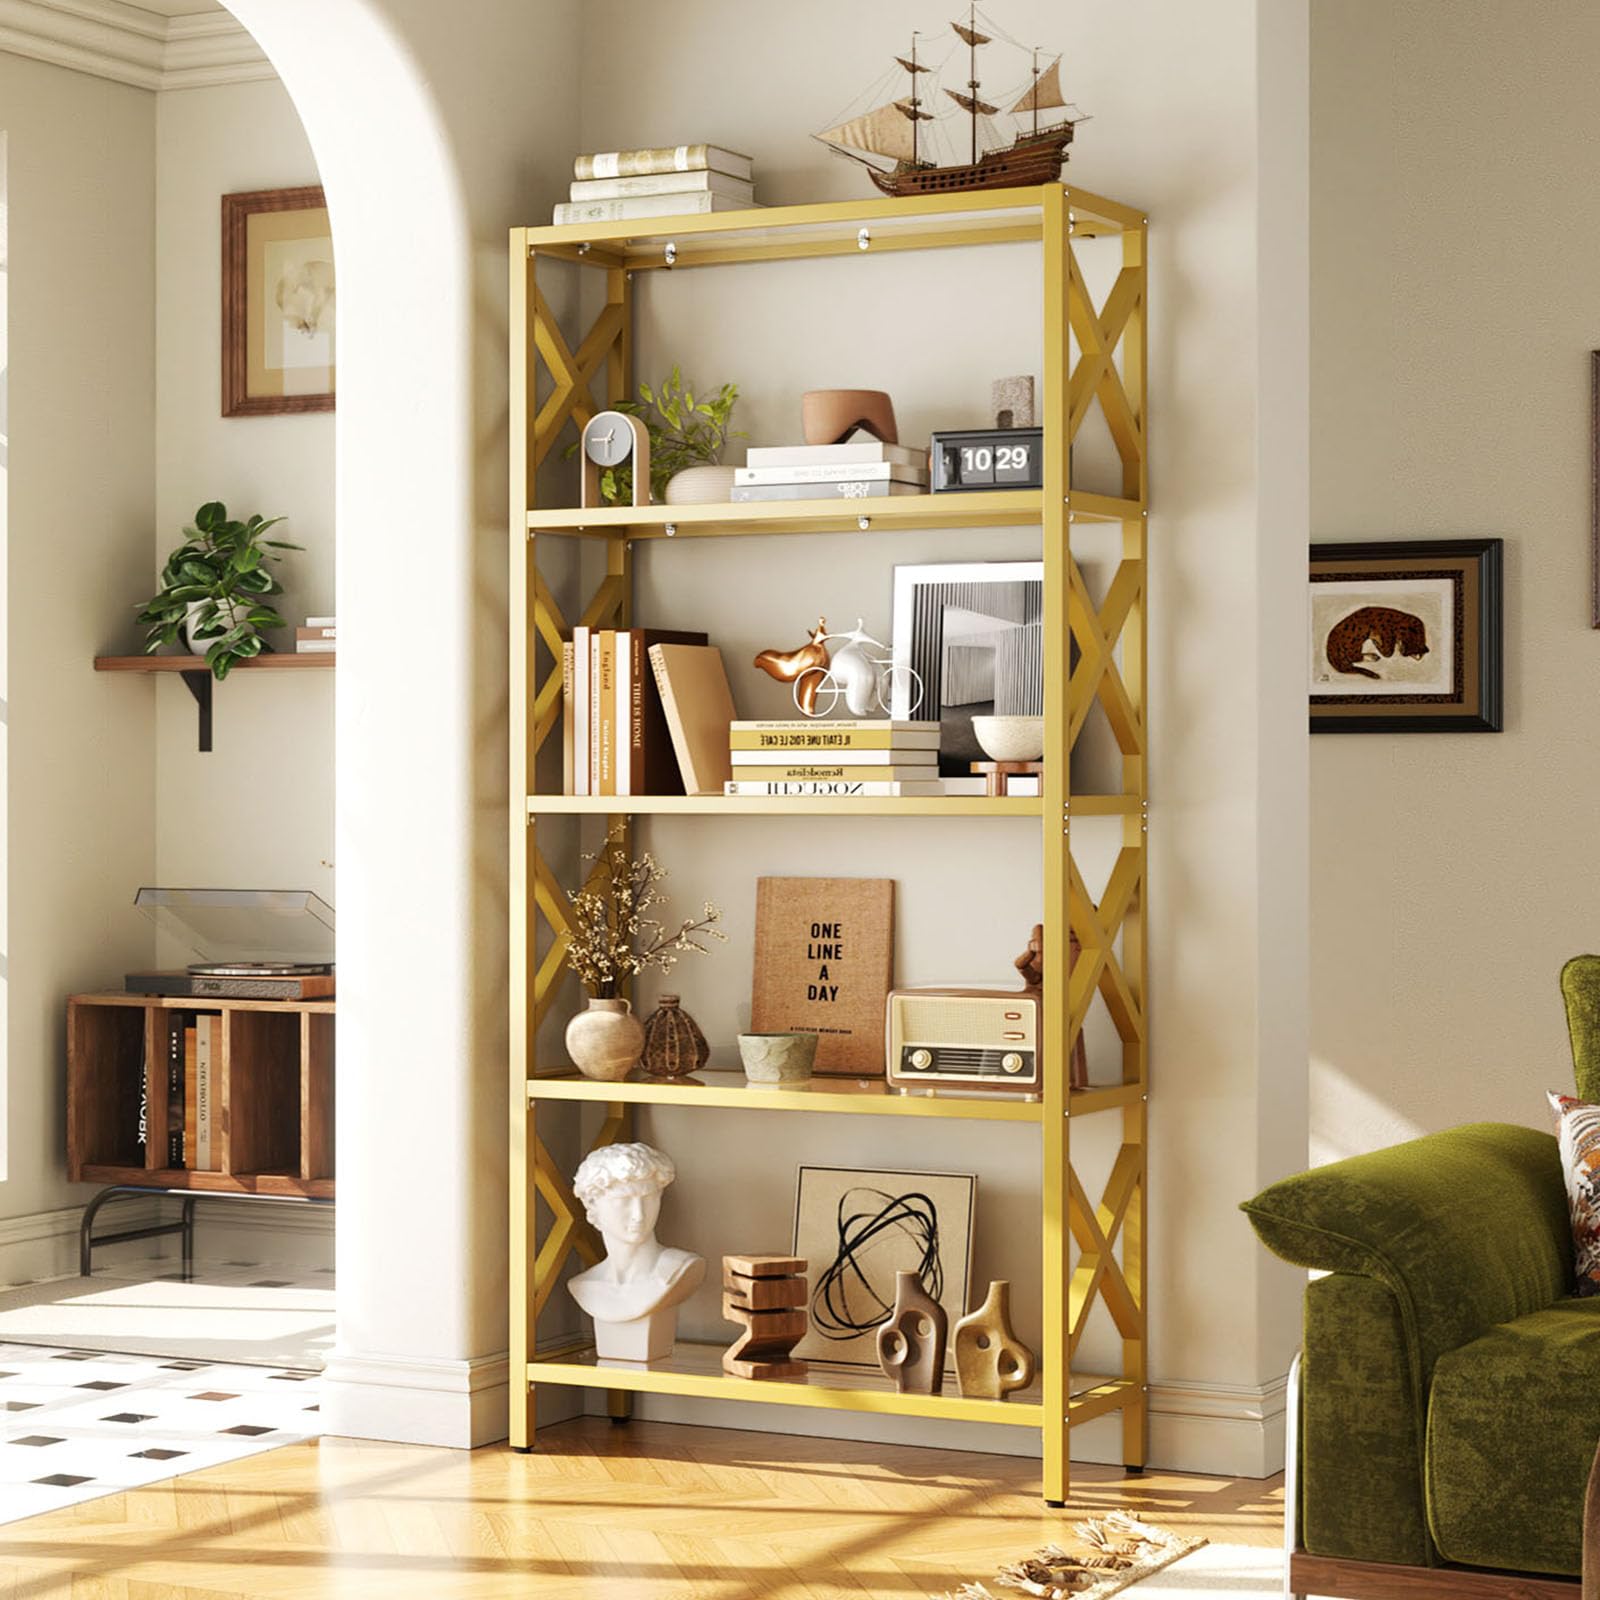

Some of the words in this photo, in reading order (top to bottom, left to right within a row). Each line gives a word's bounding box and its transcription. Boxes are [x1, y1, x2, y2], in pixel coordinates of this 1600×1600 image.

[964, 448, 991, 471] 10
[995, 447, 1028, 470] 29
[602, 650, 611, 691] England
[633, 681, 641, 705] THIS
[633, 706, 641, 717] IS
[633, 718, 641, 749] HOME
[811, 923, 842, 939] ONE
[807, 944, 843, 960] LINE
[819, 965, 829, 981] A
[807, 985, 839, 1002] DAY
